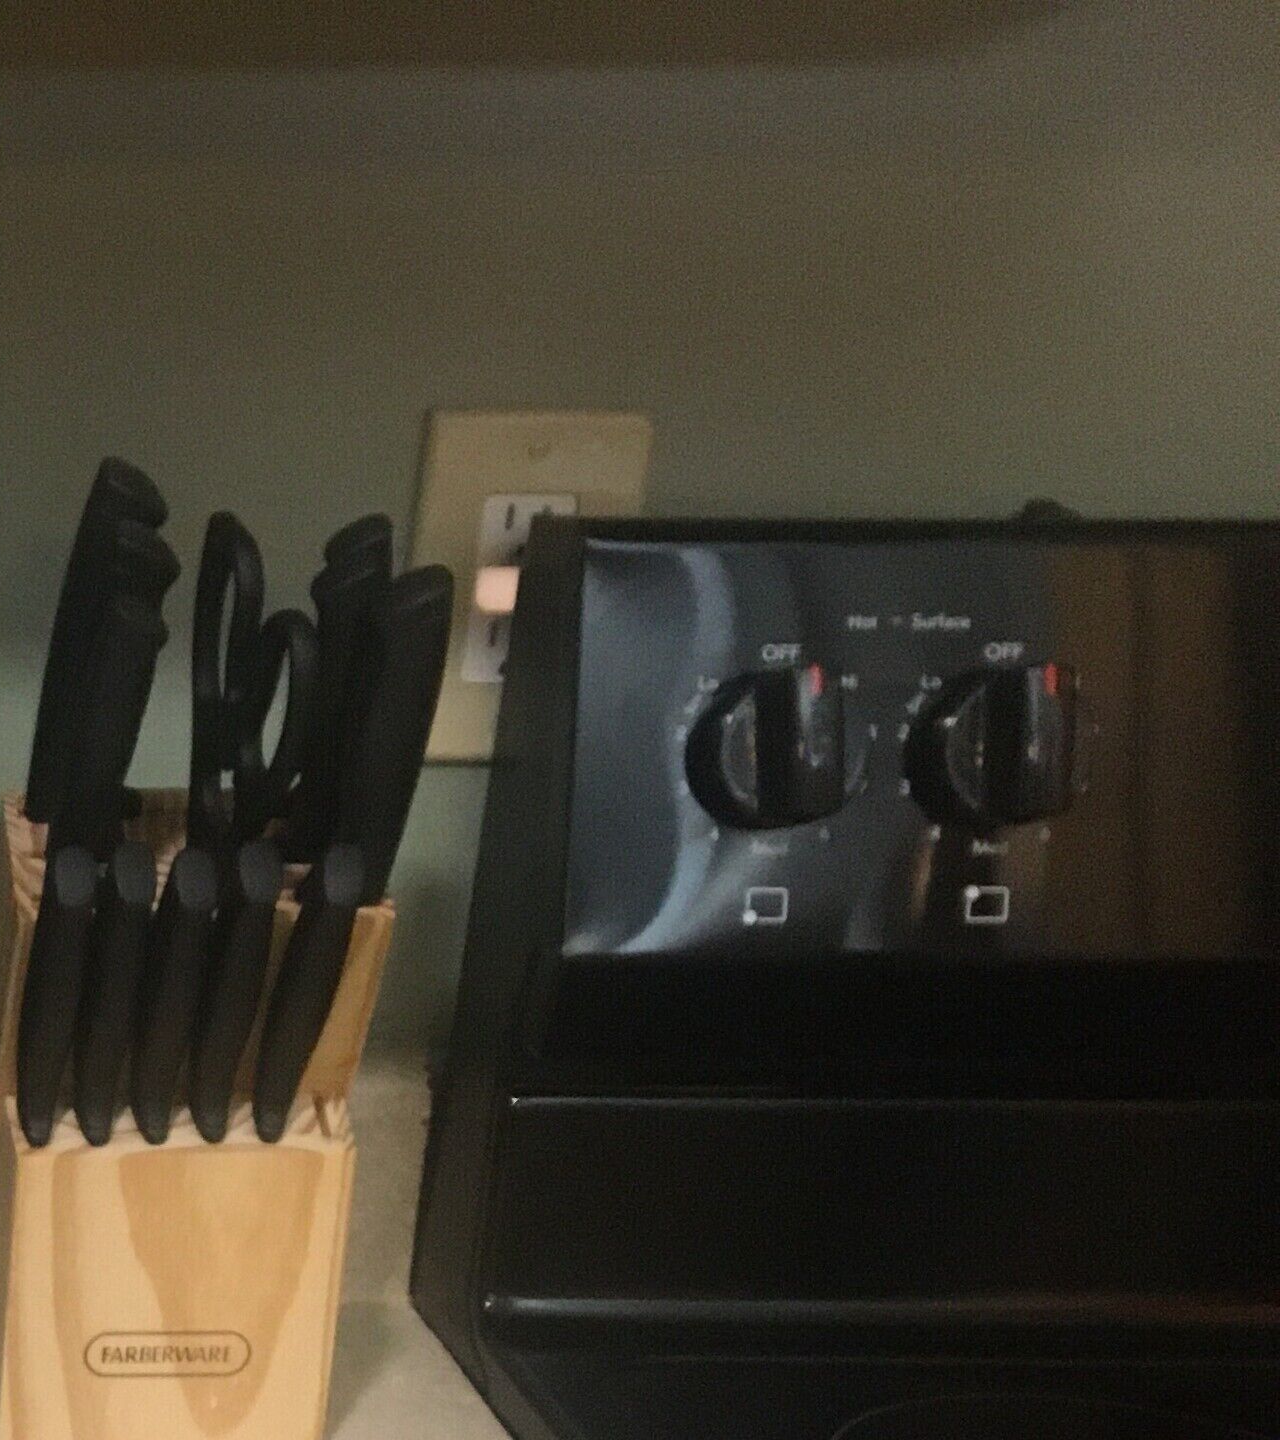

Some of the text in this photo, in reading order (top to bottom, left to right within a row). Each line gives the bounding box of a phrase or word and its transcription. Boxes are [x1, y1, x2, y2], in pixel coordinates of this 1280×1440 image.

[761, 643, 802, 662] OFF
[984, 641, 1024, 662] OFF
[100, 1346, 232, 1363] FARBERWARE
